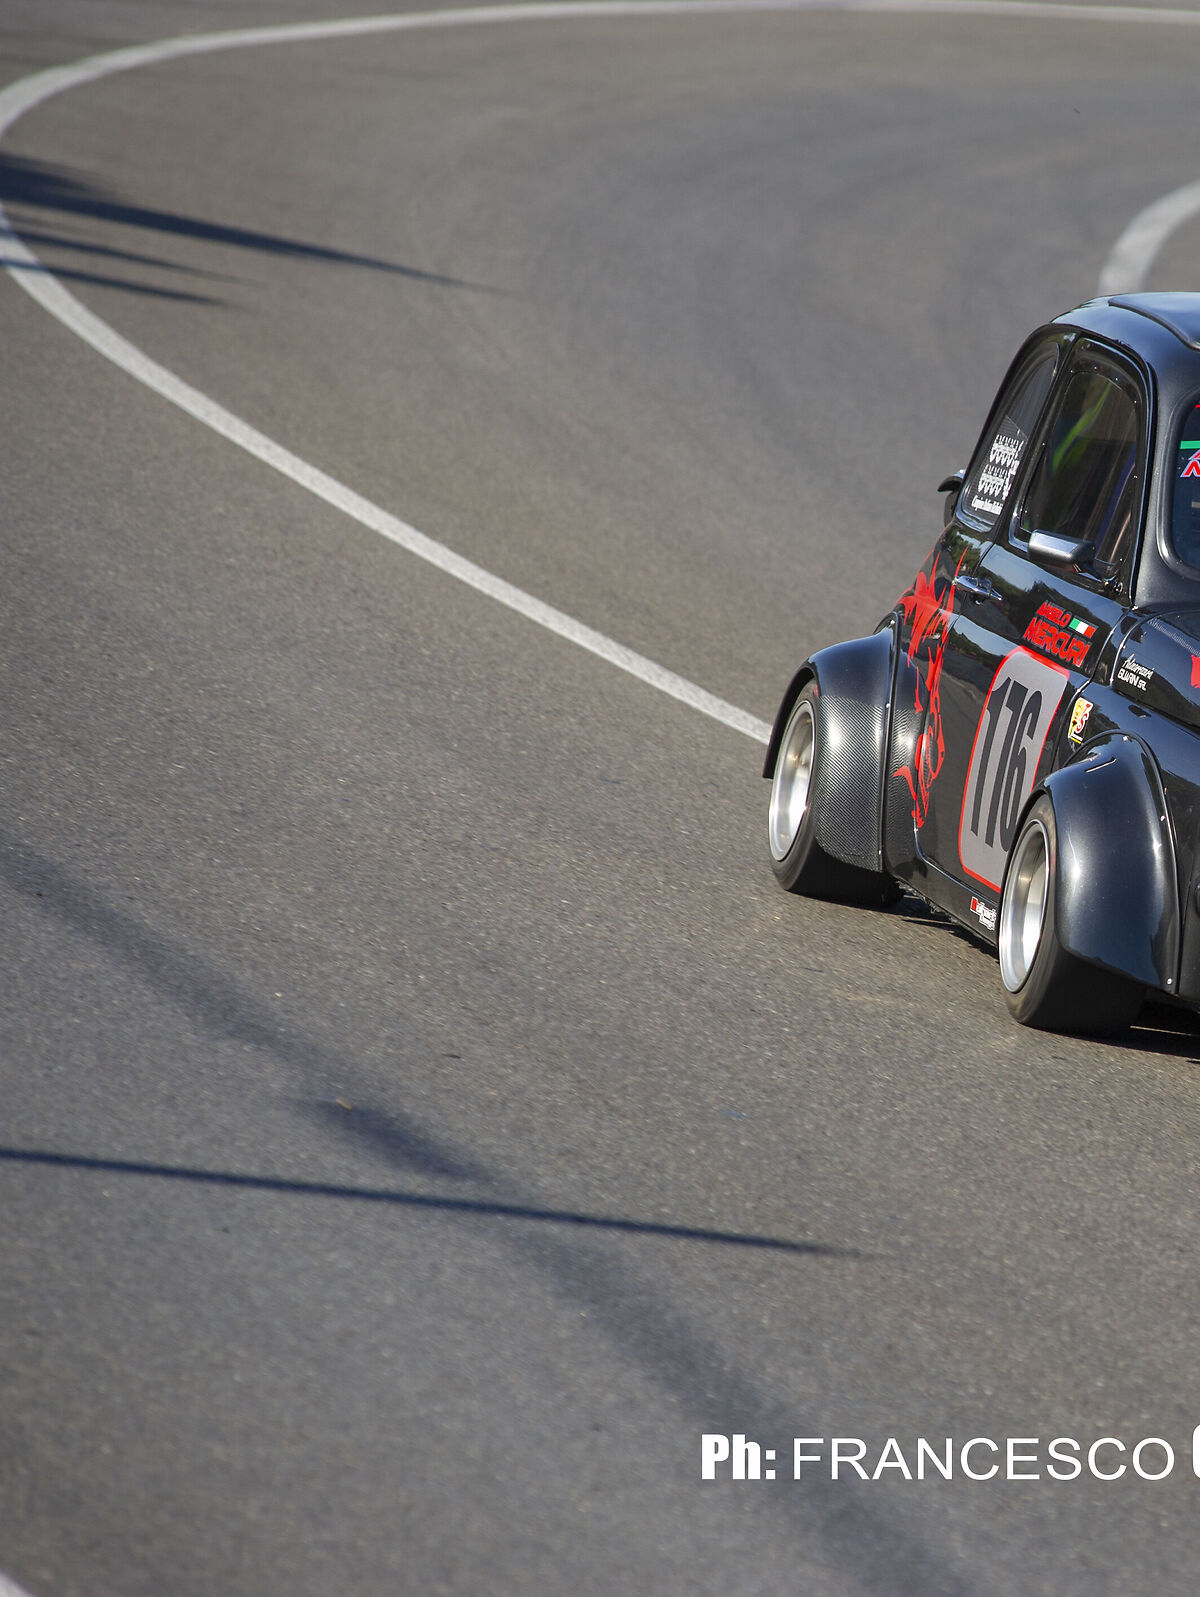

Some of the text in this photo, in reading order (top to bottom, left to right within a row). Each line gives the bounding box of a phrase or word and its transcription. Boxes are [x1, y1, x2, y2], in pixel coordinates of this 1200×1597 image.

[1036, 600, 1072, 627] ANGELO
[1023, 616, 1091, 668] MERCURI
[970, 676, 1043, 853] 176
